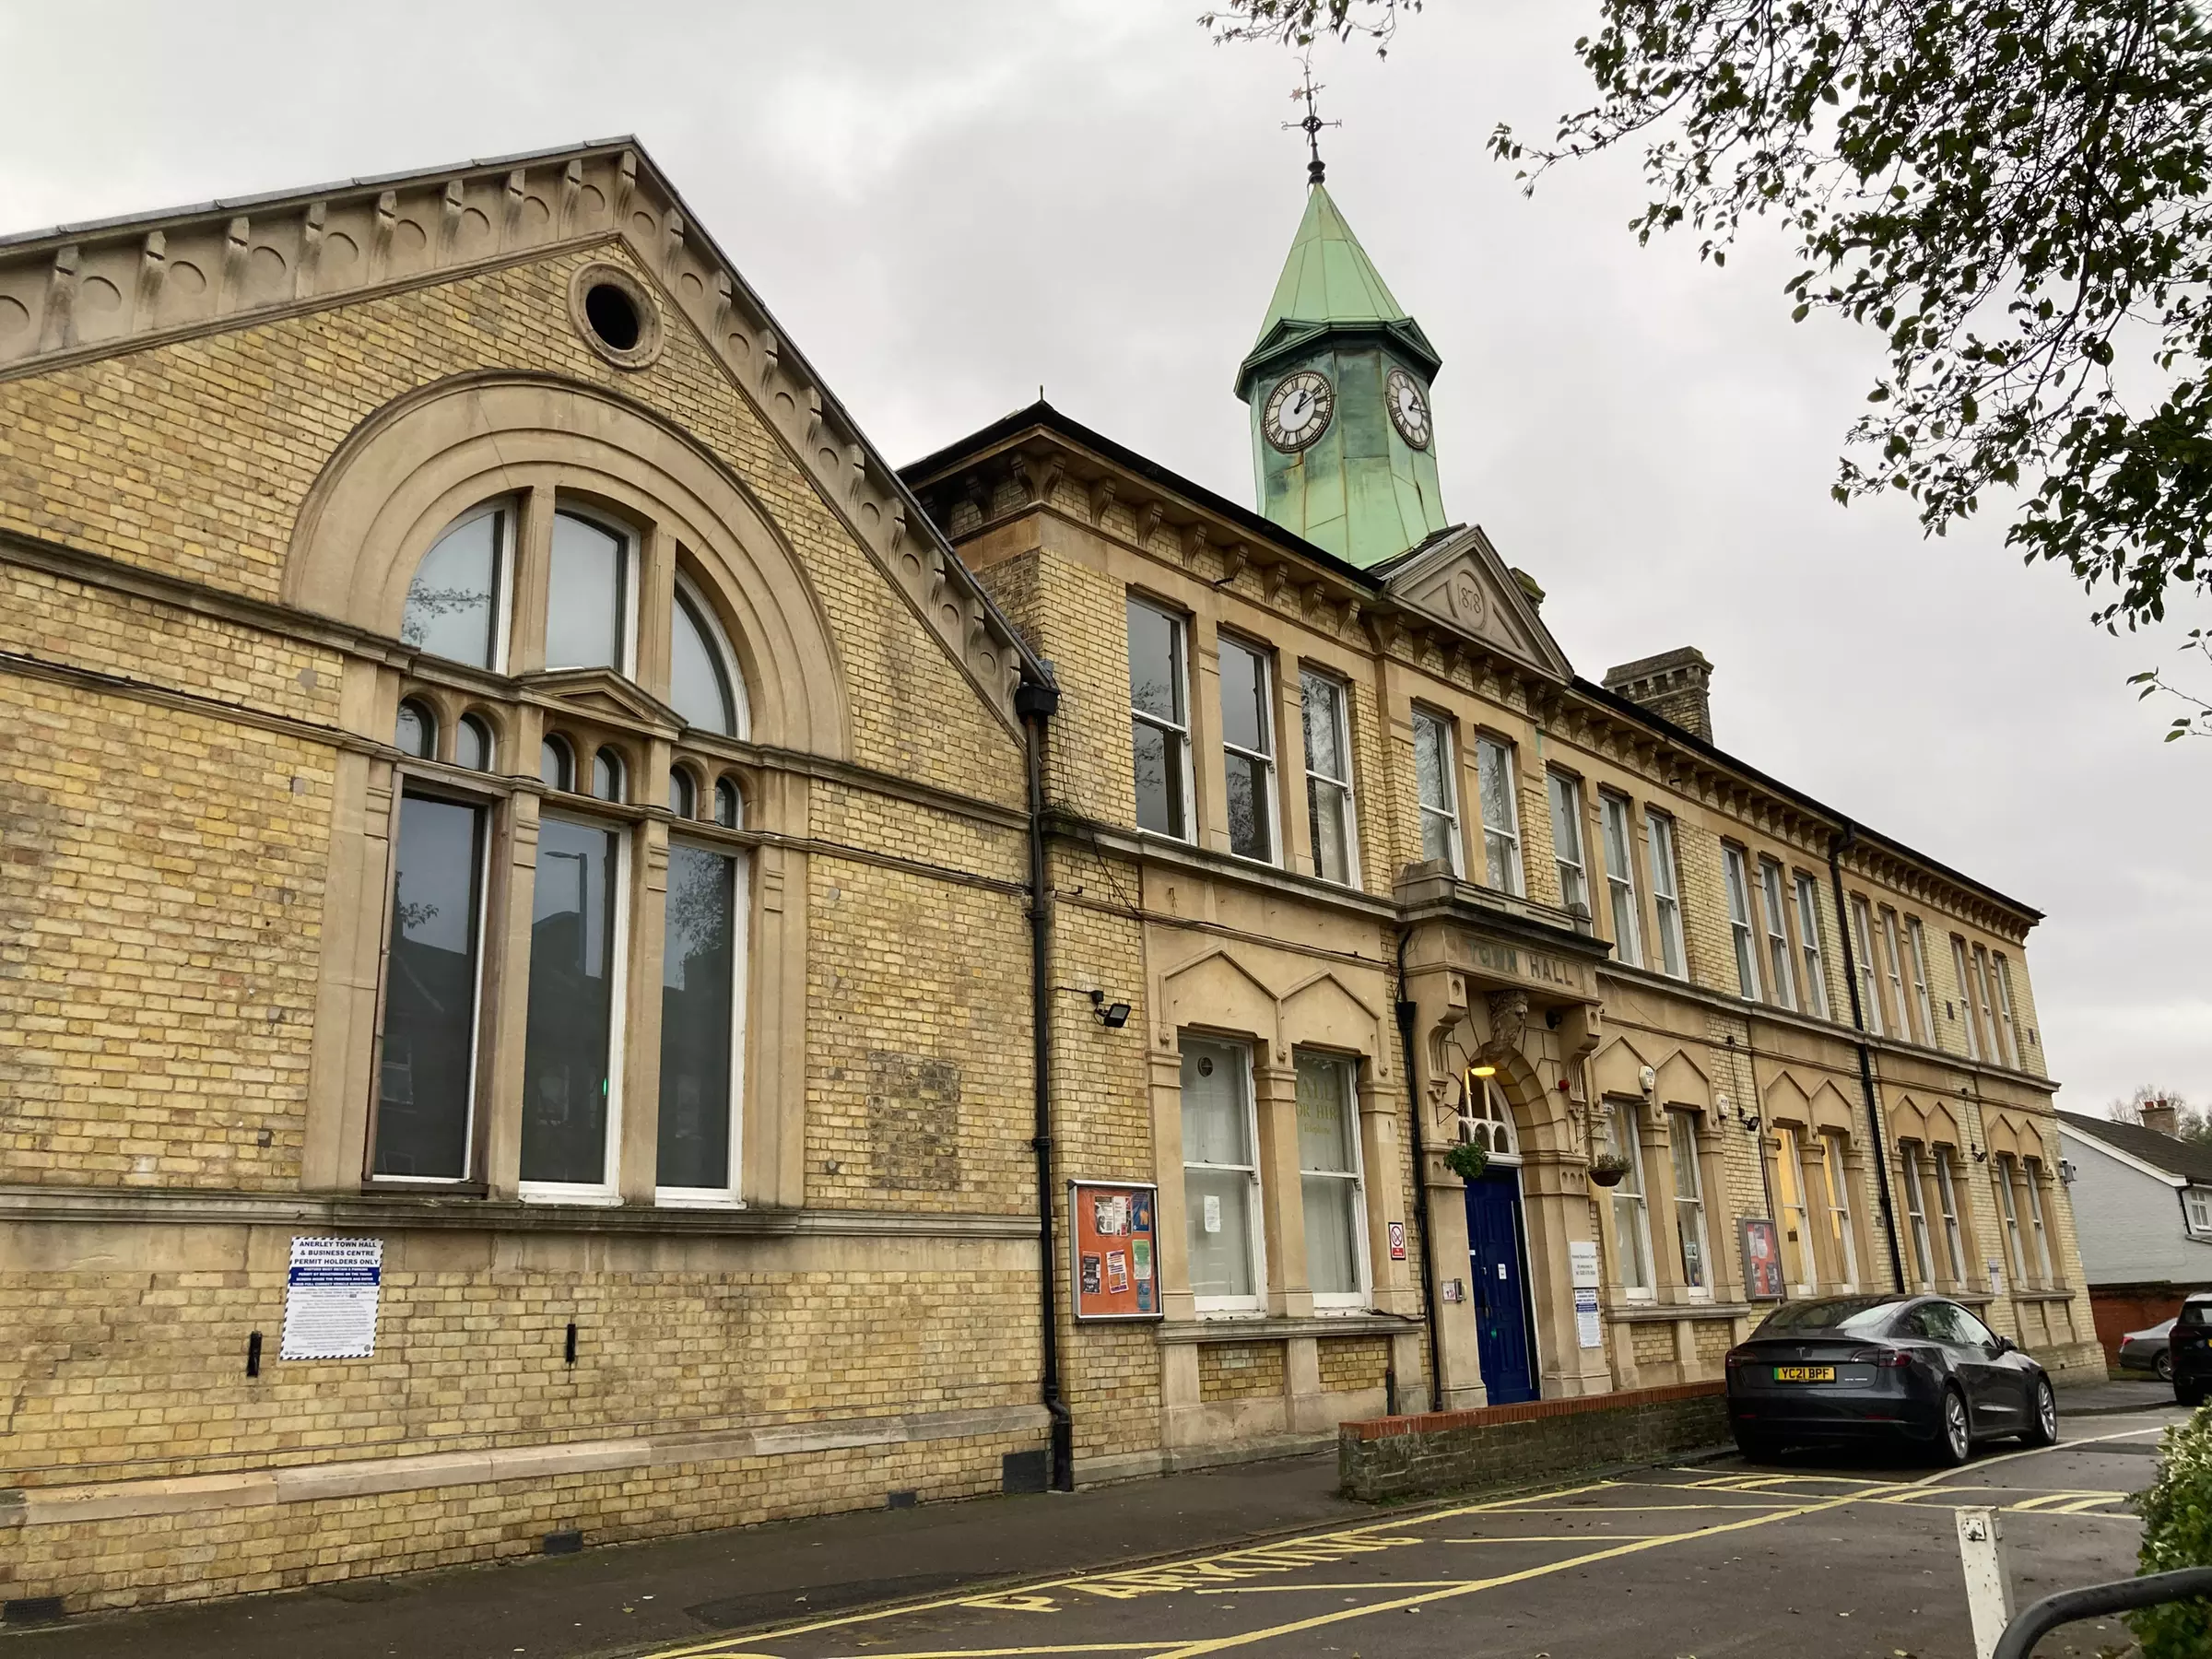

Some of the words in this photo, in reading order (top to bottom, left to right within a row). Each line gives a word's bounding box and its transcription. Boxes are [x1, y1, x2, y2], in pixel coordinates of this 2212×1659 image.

[1456, 583, 1481, 614] 1878
[1466, 940, 1519, 973] TOWN
[1529, 955, 1574, 986] HALL
[1295, 1102, 1311, 1118] OR
[1316, 1104, 1339, 1121] HIR
[1782, 1368, 1806, 1379] YC21
[1808, 1368, 1830, 1379] BPF
[959, 1533, 1425, 1612] PARKING
